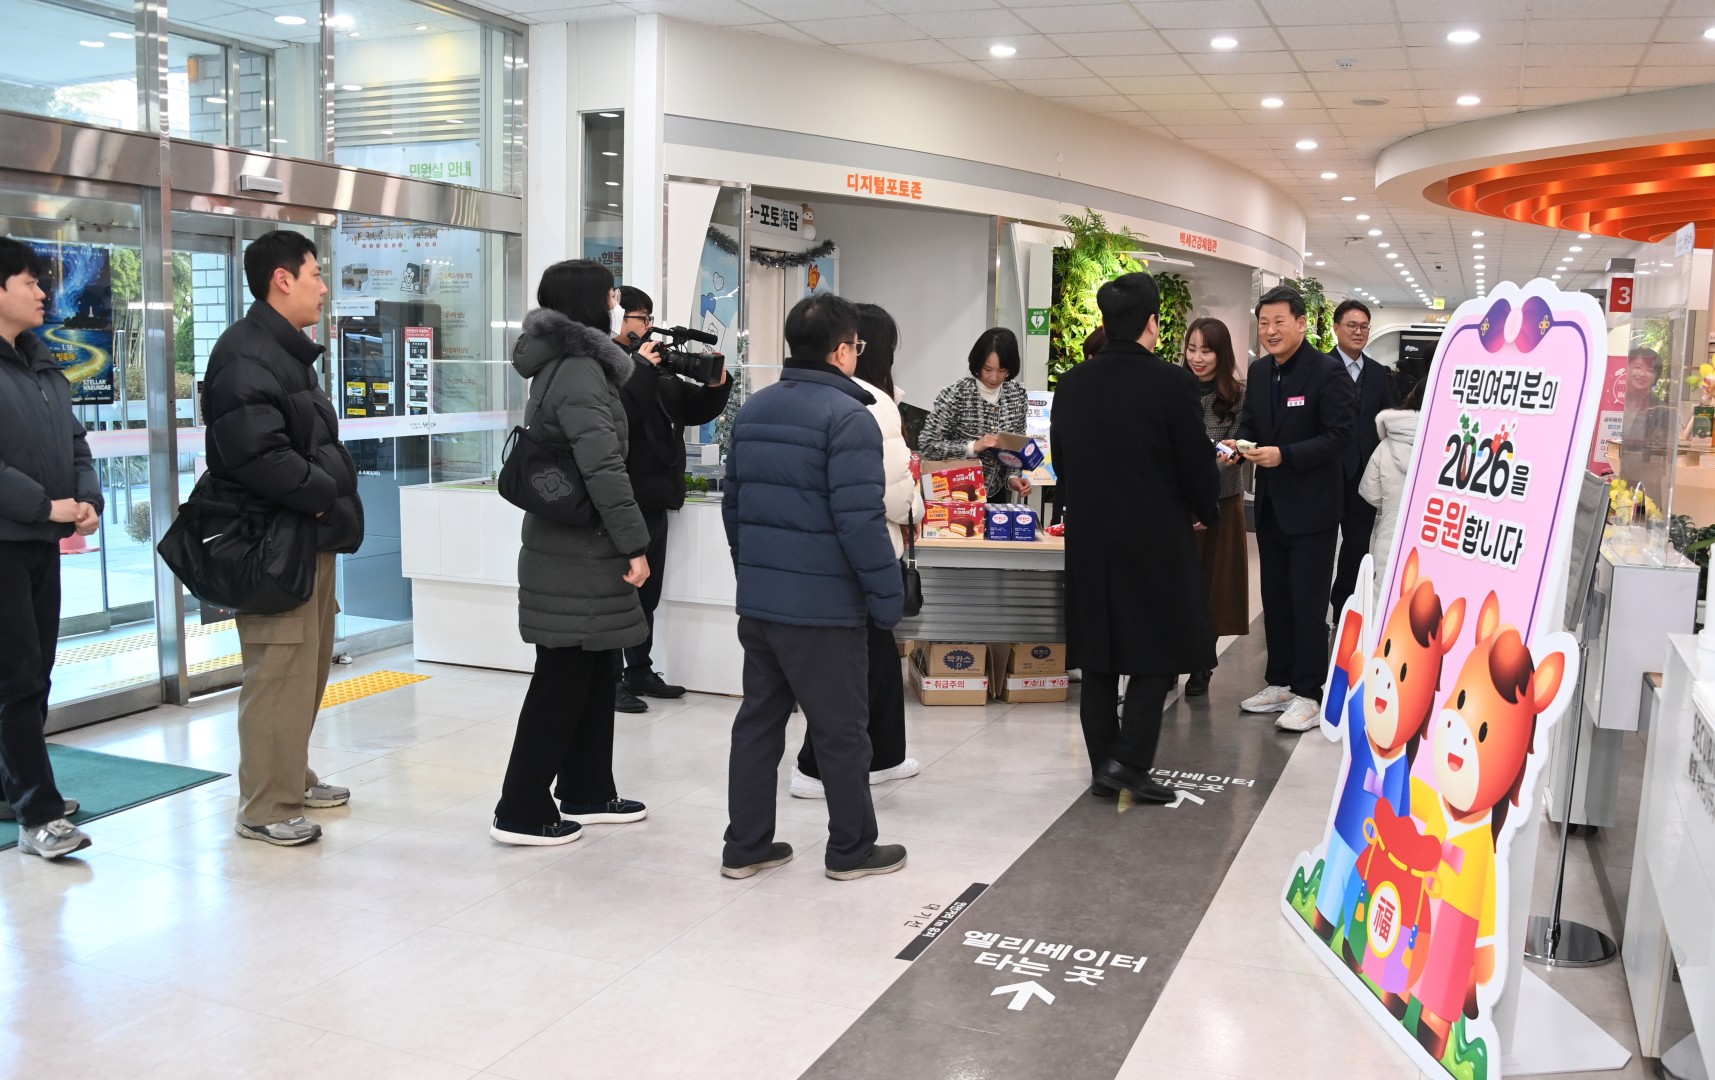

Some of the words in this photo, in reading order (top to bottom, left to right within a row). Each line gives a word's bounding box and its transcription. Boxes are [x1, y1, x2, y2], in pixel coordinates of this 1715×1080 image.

[409, 161, 444, 179] 민원실
[447, 160, 472, 178] 안내
[847, 173, 923, 200] 디지털포토존
[1618, 286, 1631, 305] 3
[1452, 369, 1559, 409] 직원여러분의
[1420, 496, 1524, 567] 응원합니다
[947, 655, 972, 664] 박카스
[933, 680, 966, 689] 취급주의
[1147, 767, 1256, 788] 리베이터
[903, 903, 942, 928] 대기선
[1373, 895, 1396, 943] 福
[962, 930, 1149, 973] 엘리베이터
[974, 951, 1051, 977] 타는
[1063, 965, 1106, 986] 곳
